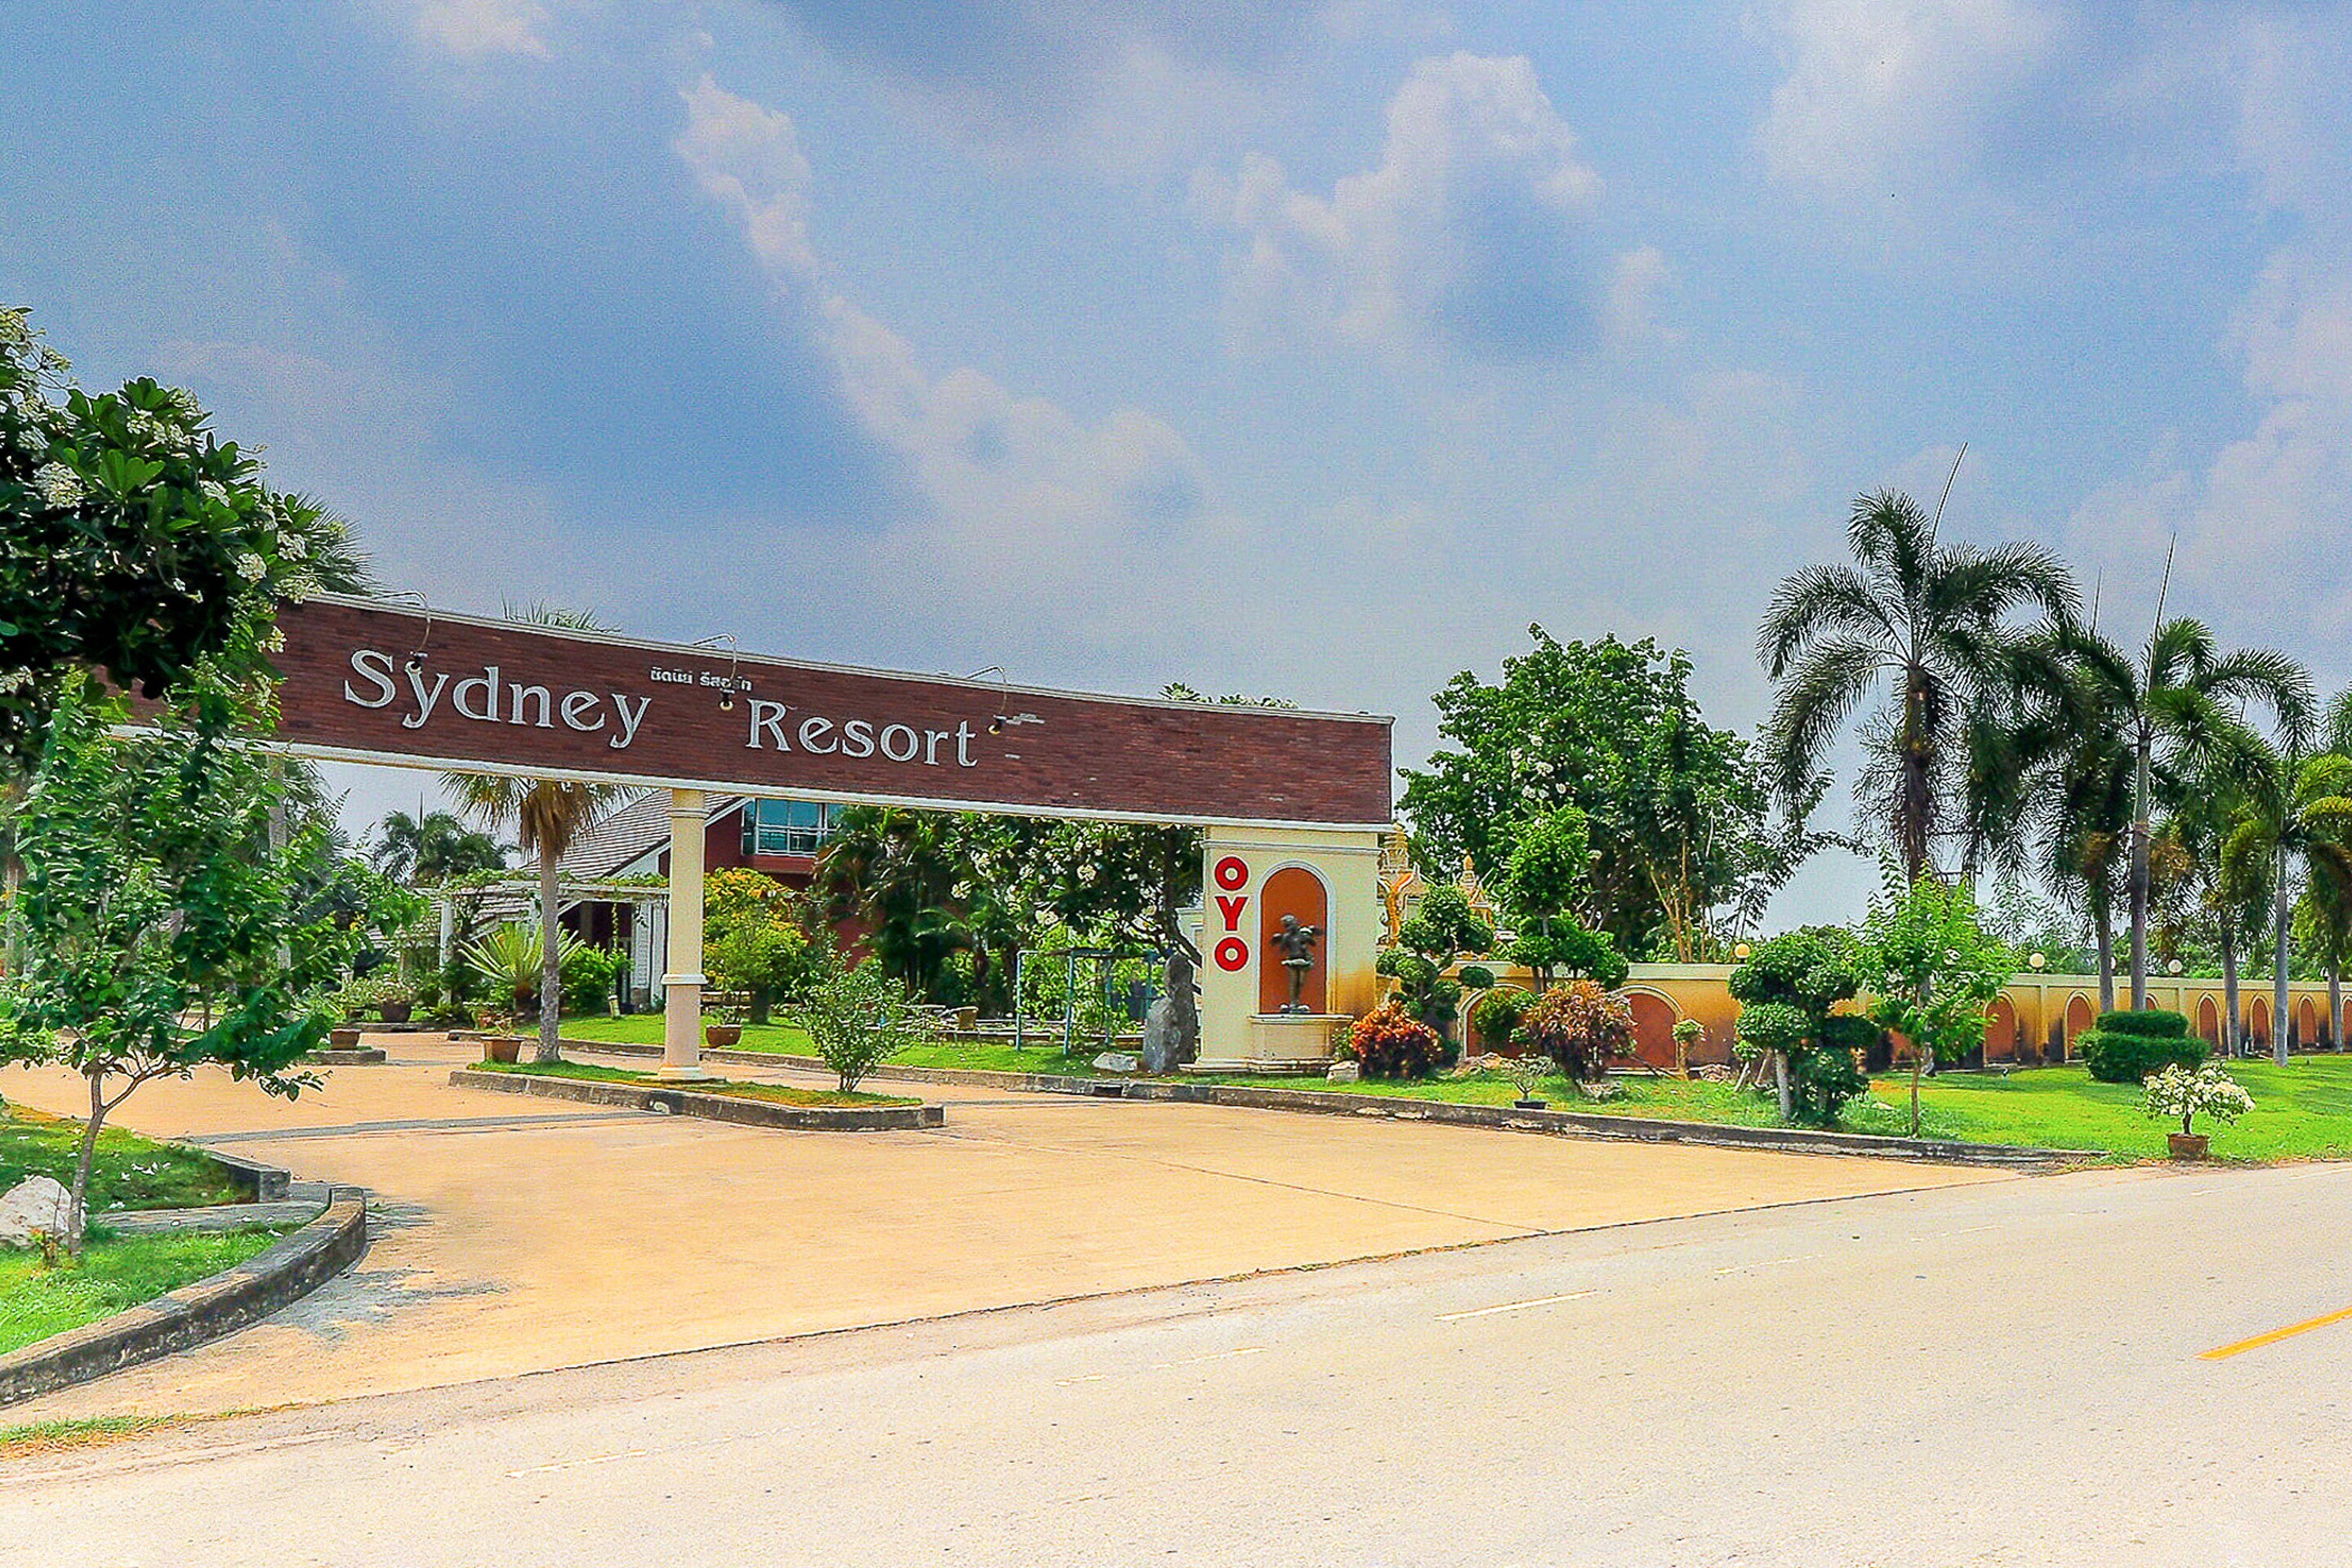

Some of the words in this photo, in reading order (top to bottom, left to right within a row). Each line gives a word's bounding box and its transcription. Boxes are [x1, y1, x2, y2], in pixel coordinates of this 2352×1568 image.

[344, 649, 653, 749] Sydney
[745, 698, 978, 768] Resort
[1214, 855, 1250, 973] OYO
